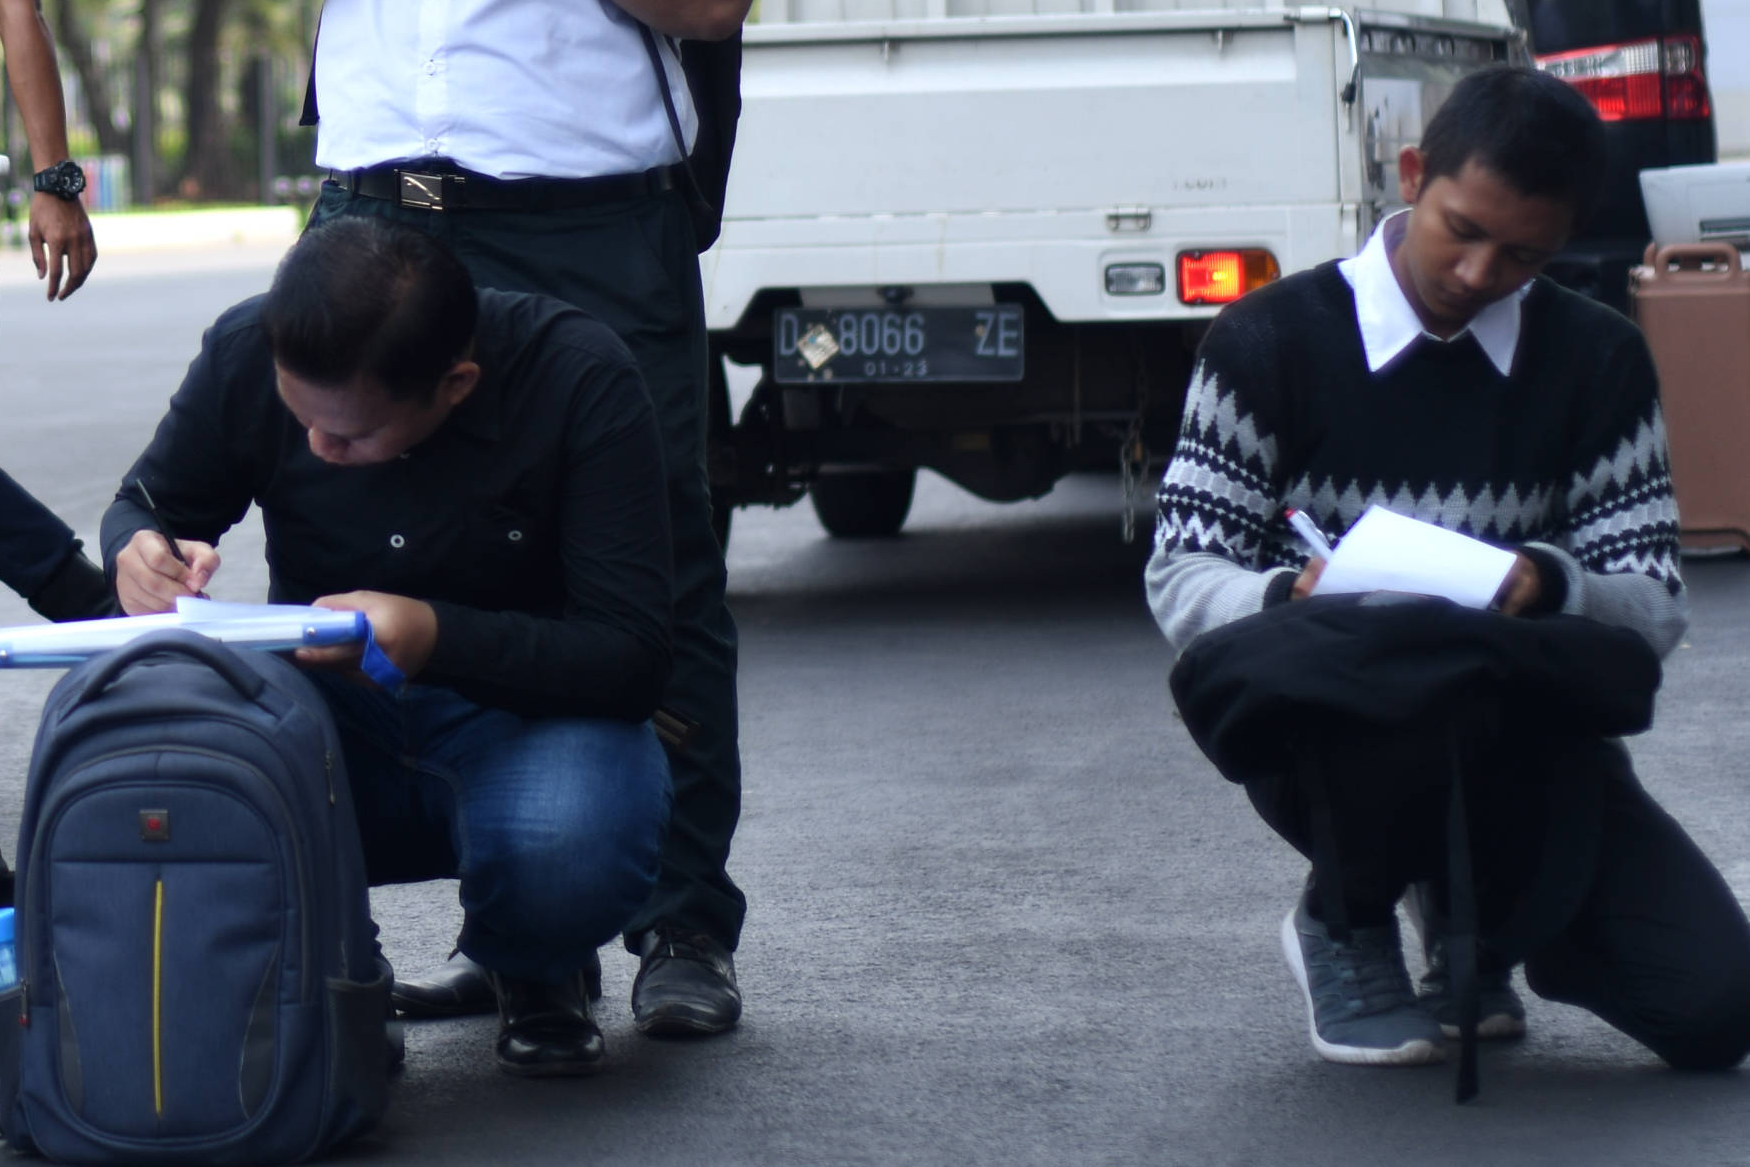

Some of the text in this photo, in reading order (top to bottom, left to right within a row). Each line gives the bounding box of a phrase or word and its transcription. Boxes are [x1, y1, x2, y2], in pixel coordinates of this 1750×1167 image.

[779, 312, 1019, 357] D 8066 ZE
